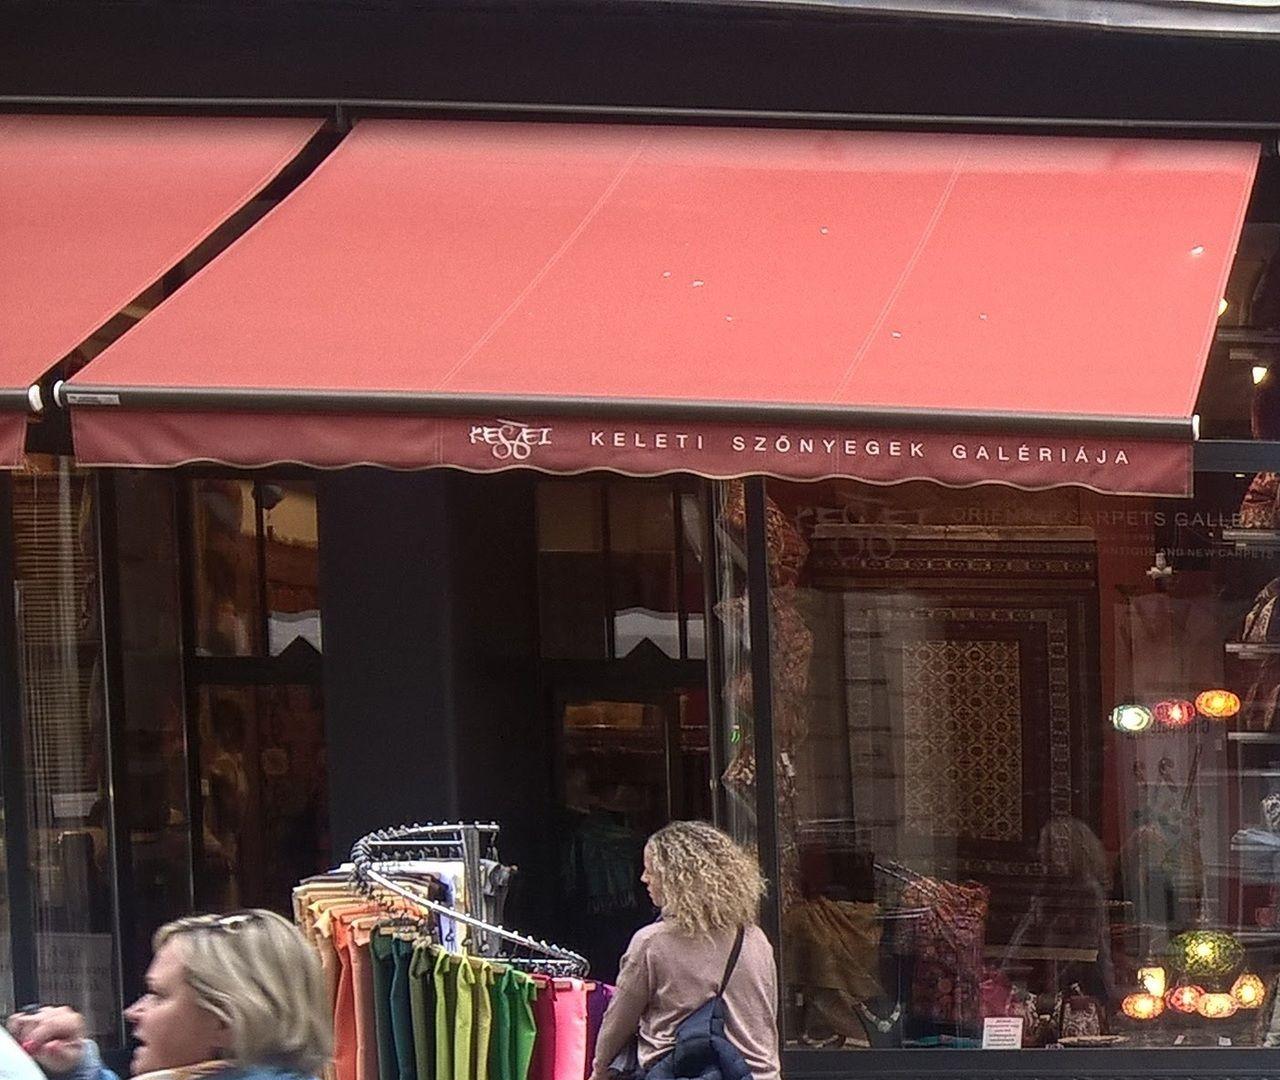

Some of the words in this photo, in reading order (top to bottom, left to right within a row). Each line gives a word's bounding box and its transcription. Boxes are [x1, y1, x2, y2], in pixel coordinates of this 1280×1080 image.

[590, 432, 704, 450] KELETI
[731, 435, 925, 458] SZŐNYEGEK
[951, 442, 1132, 466] GALÉRIÁJA
